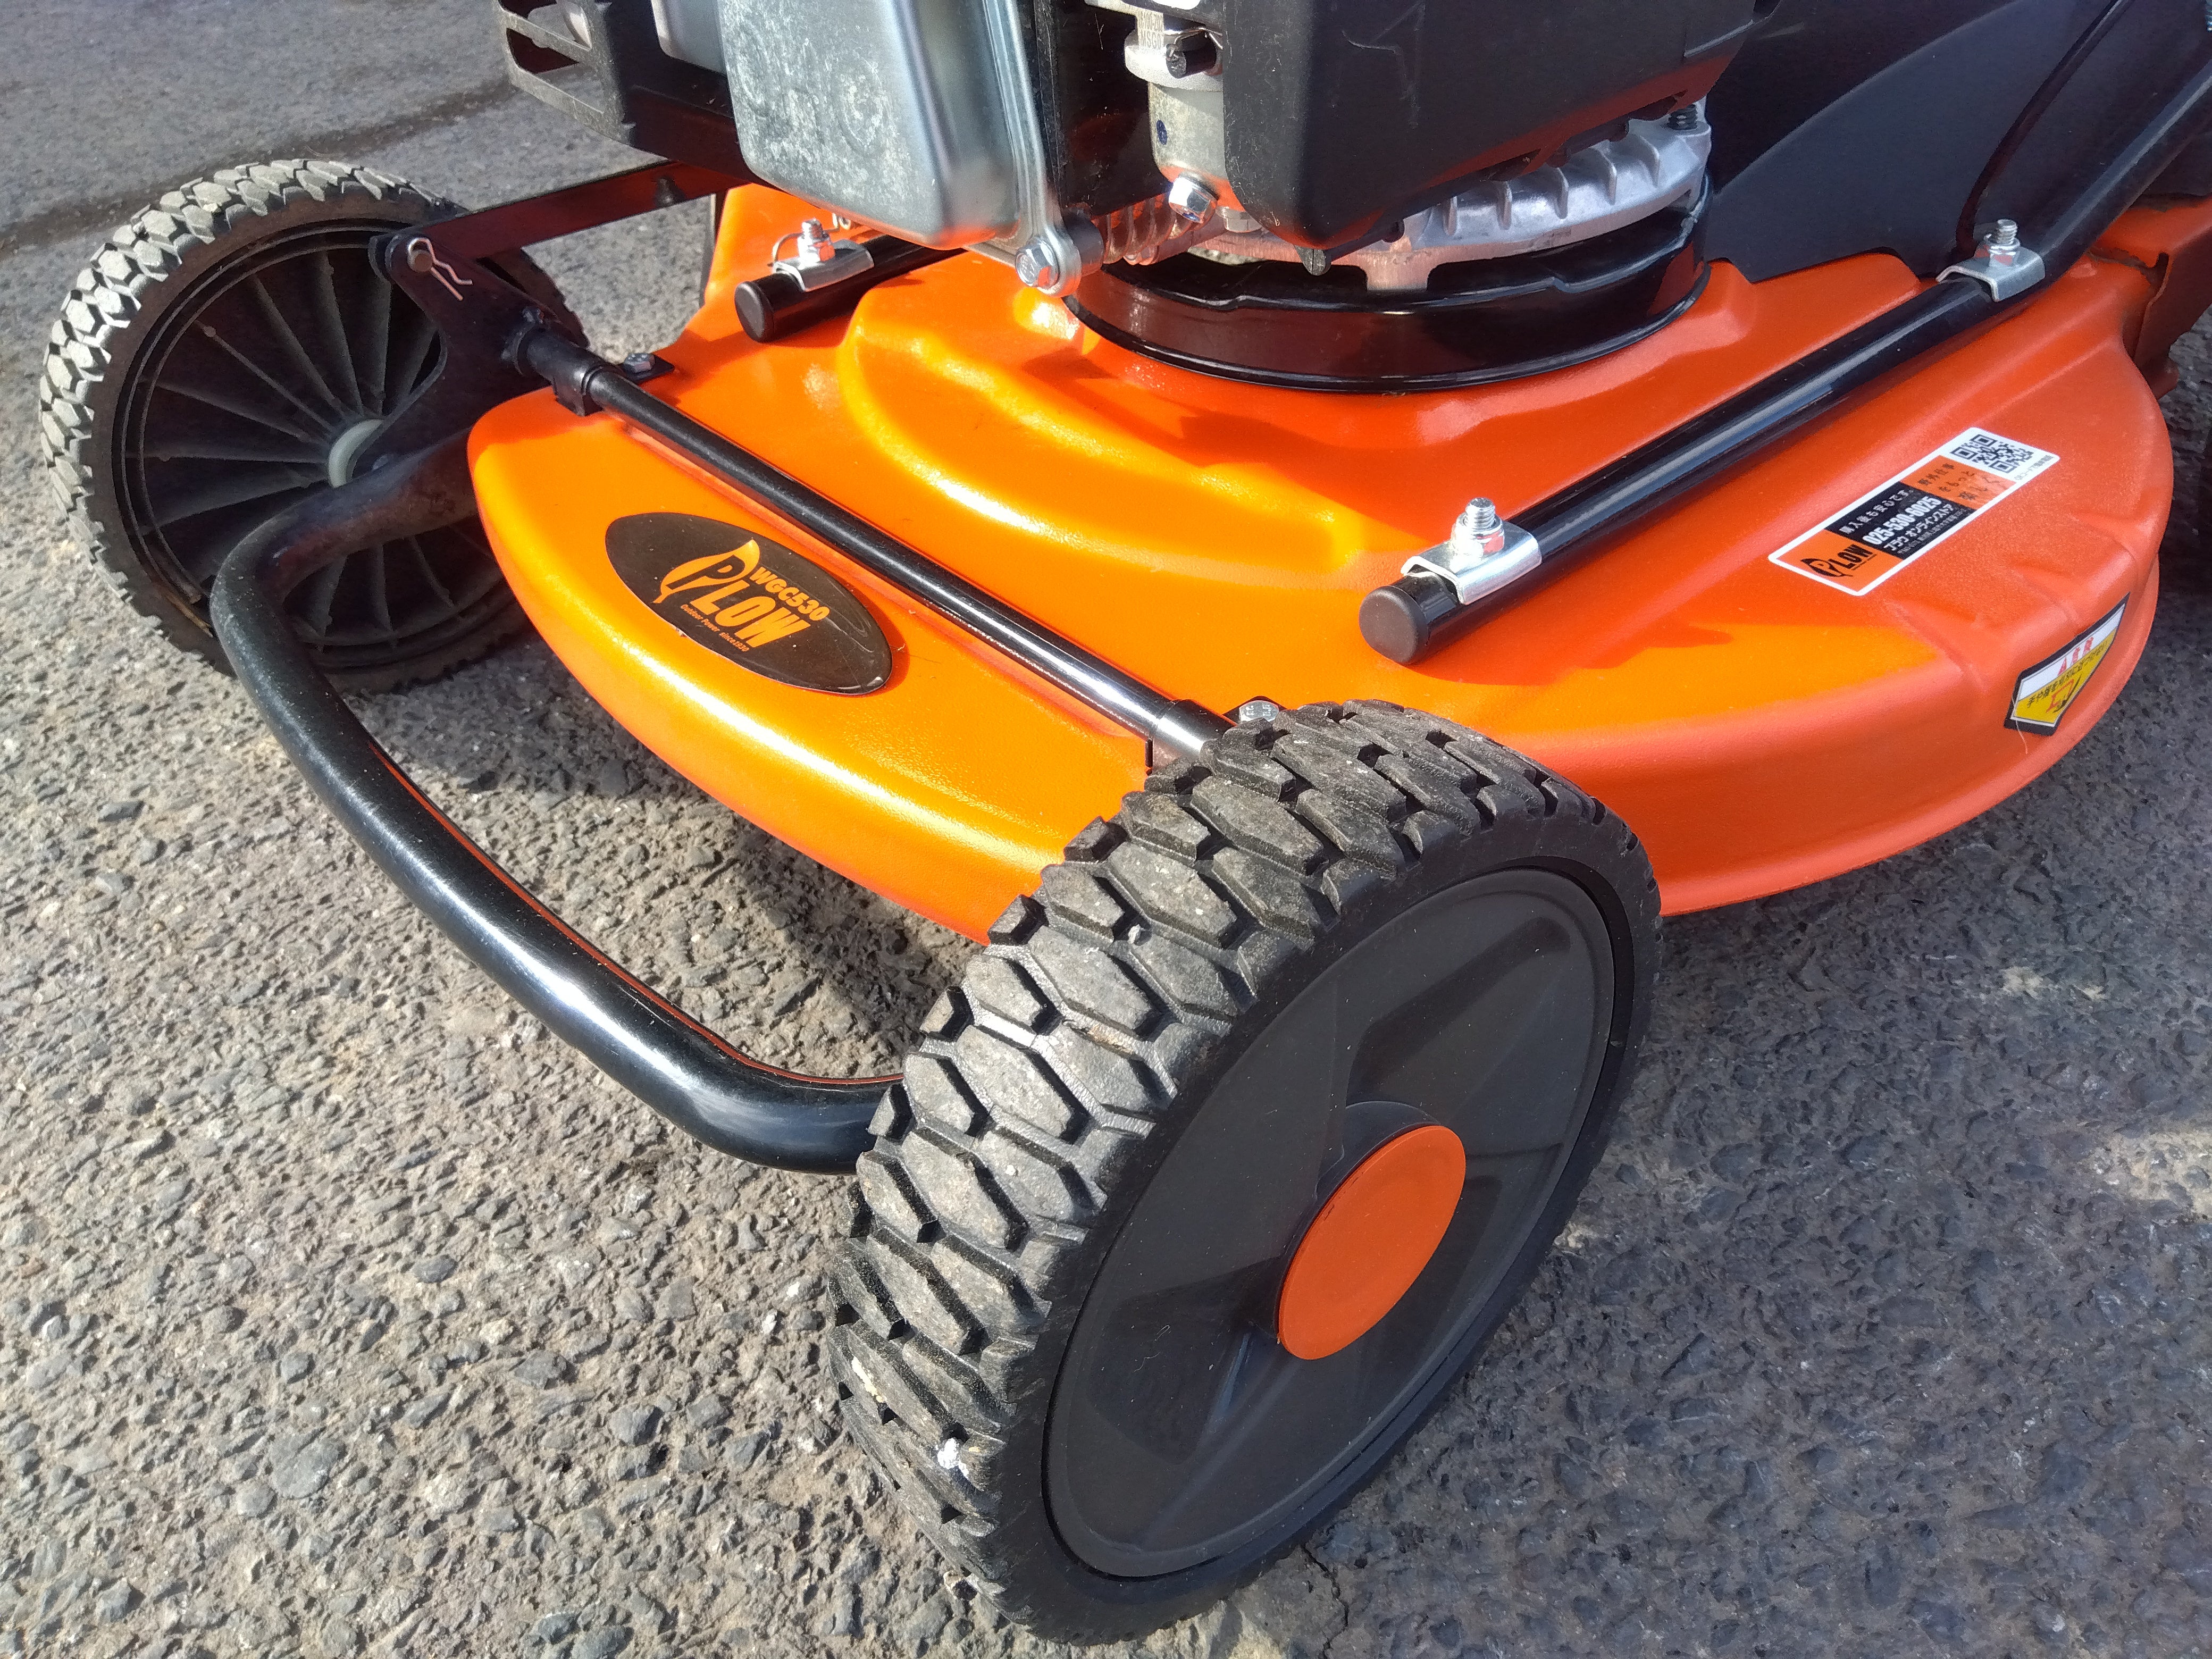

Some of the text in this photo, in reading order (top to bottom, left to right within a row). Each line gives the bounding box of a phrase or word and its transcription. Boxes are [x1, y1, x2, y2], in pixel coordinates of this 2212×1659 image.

[1863, 496, 1942, 545] 025-530-6025
[1808, 544, 1873, 576] PLOW
[664, 553, 811, 647] PLOW
[681, 604, 703, 621] Outdoor
[701, 618, 720, 632] Power
[750, 567, 830, 621] WGC530
